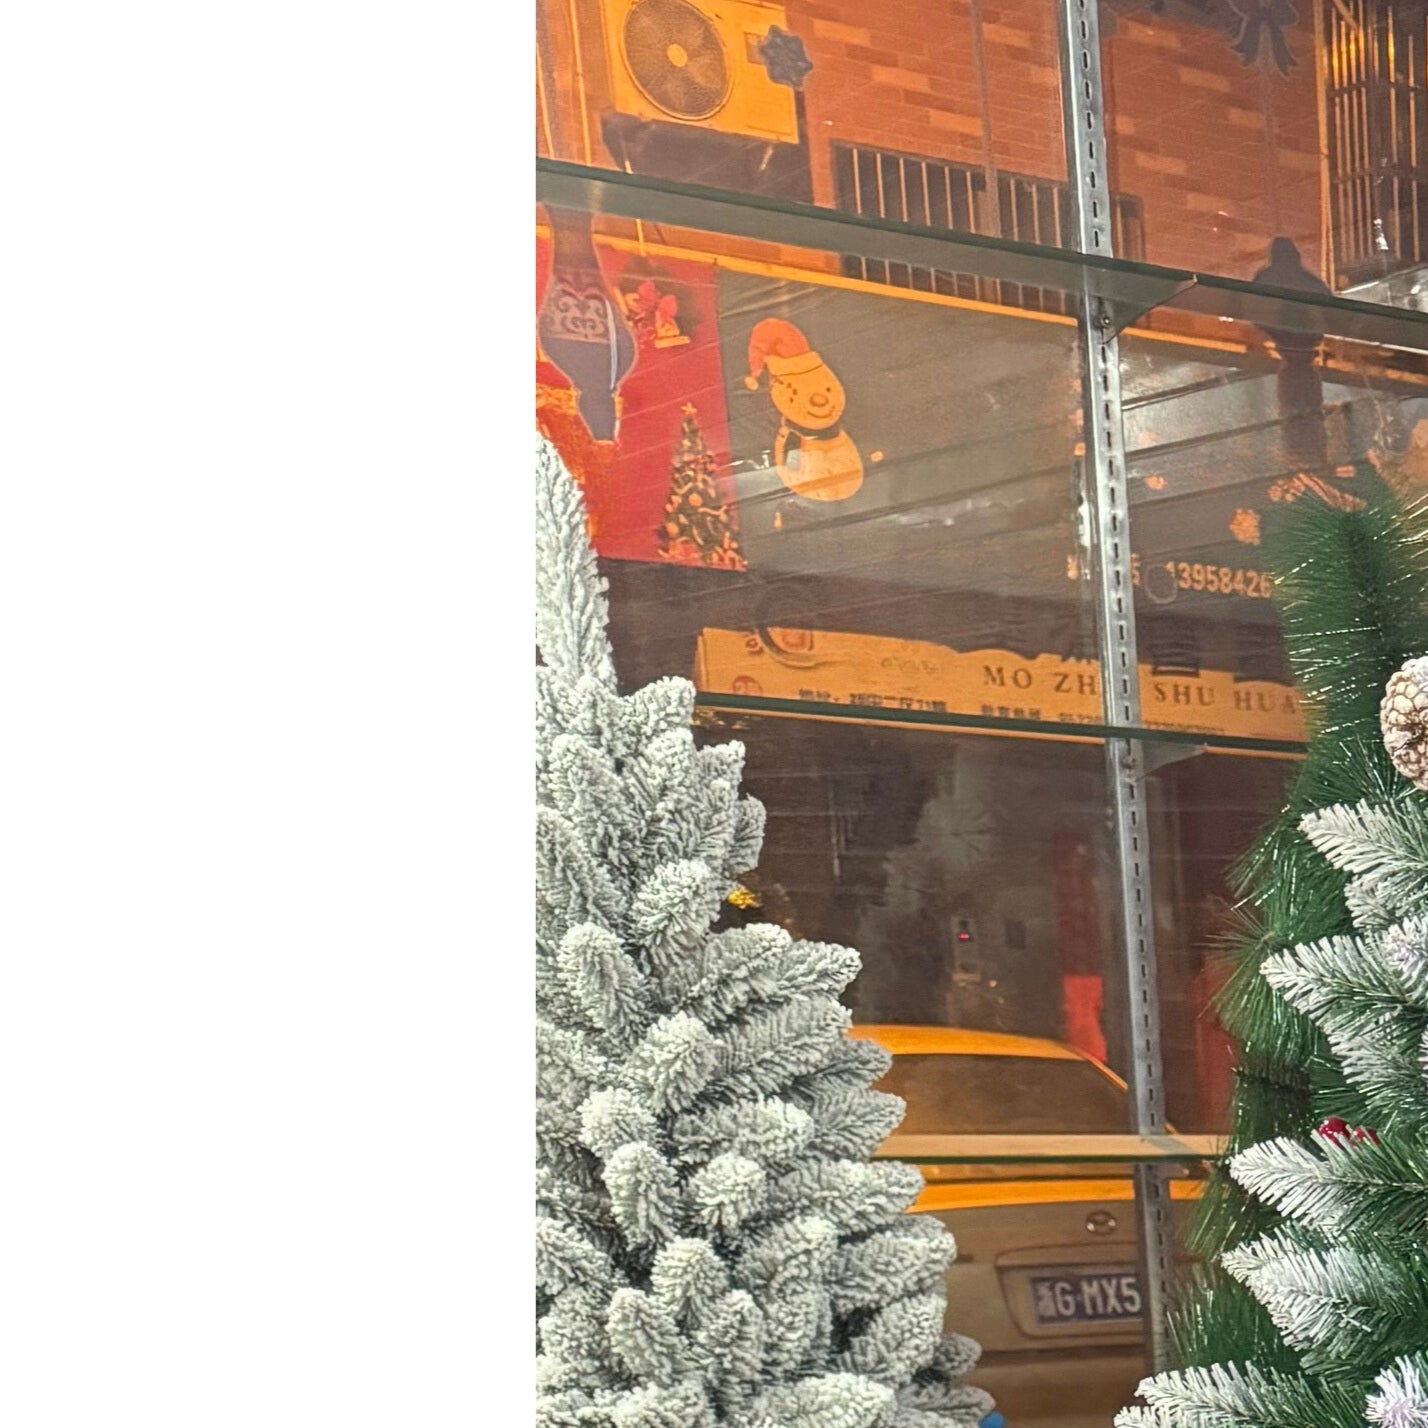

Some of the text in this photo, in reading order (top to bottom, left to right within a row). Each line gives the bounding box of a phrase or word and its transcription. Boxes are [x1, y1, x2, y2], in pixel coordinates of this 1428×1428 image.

[983, 664, 1032, 689] MO
[1053, 672, 1097, 695] ZH
[1153, 681, 1215, 707] SHU
